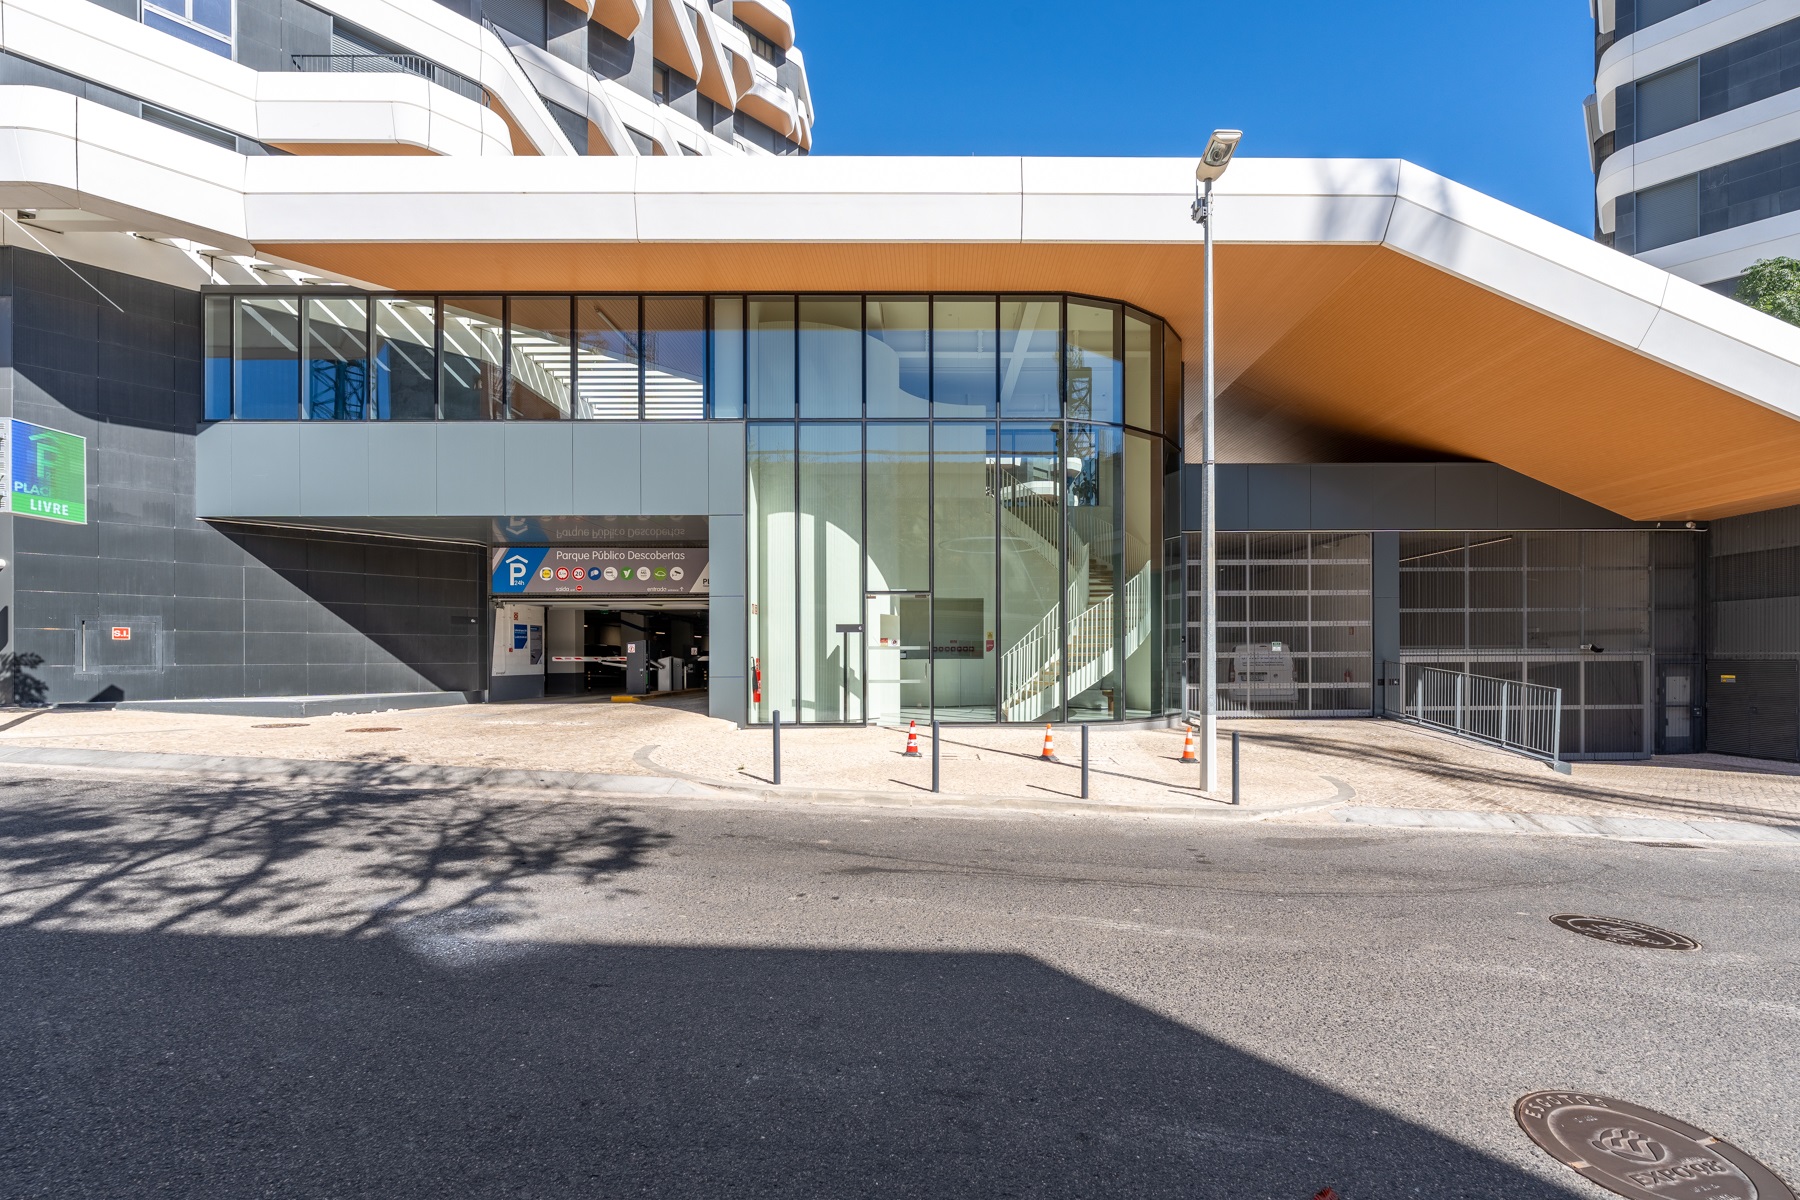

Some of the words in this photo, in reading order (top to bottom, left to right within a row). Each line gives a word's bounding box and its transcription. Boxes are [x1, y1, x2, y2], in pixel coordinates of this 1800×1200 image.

[30, 498, 69, 516] LIVRE
[556, 550, 589, 562] Parque
[592, 550, 625, 560] Público
[627, 550, 685, 560] Descobertas
[509, 563, 527, 586] P
[113, 629, 129, 638] S.I.
